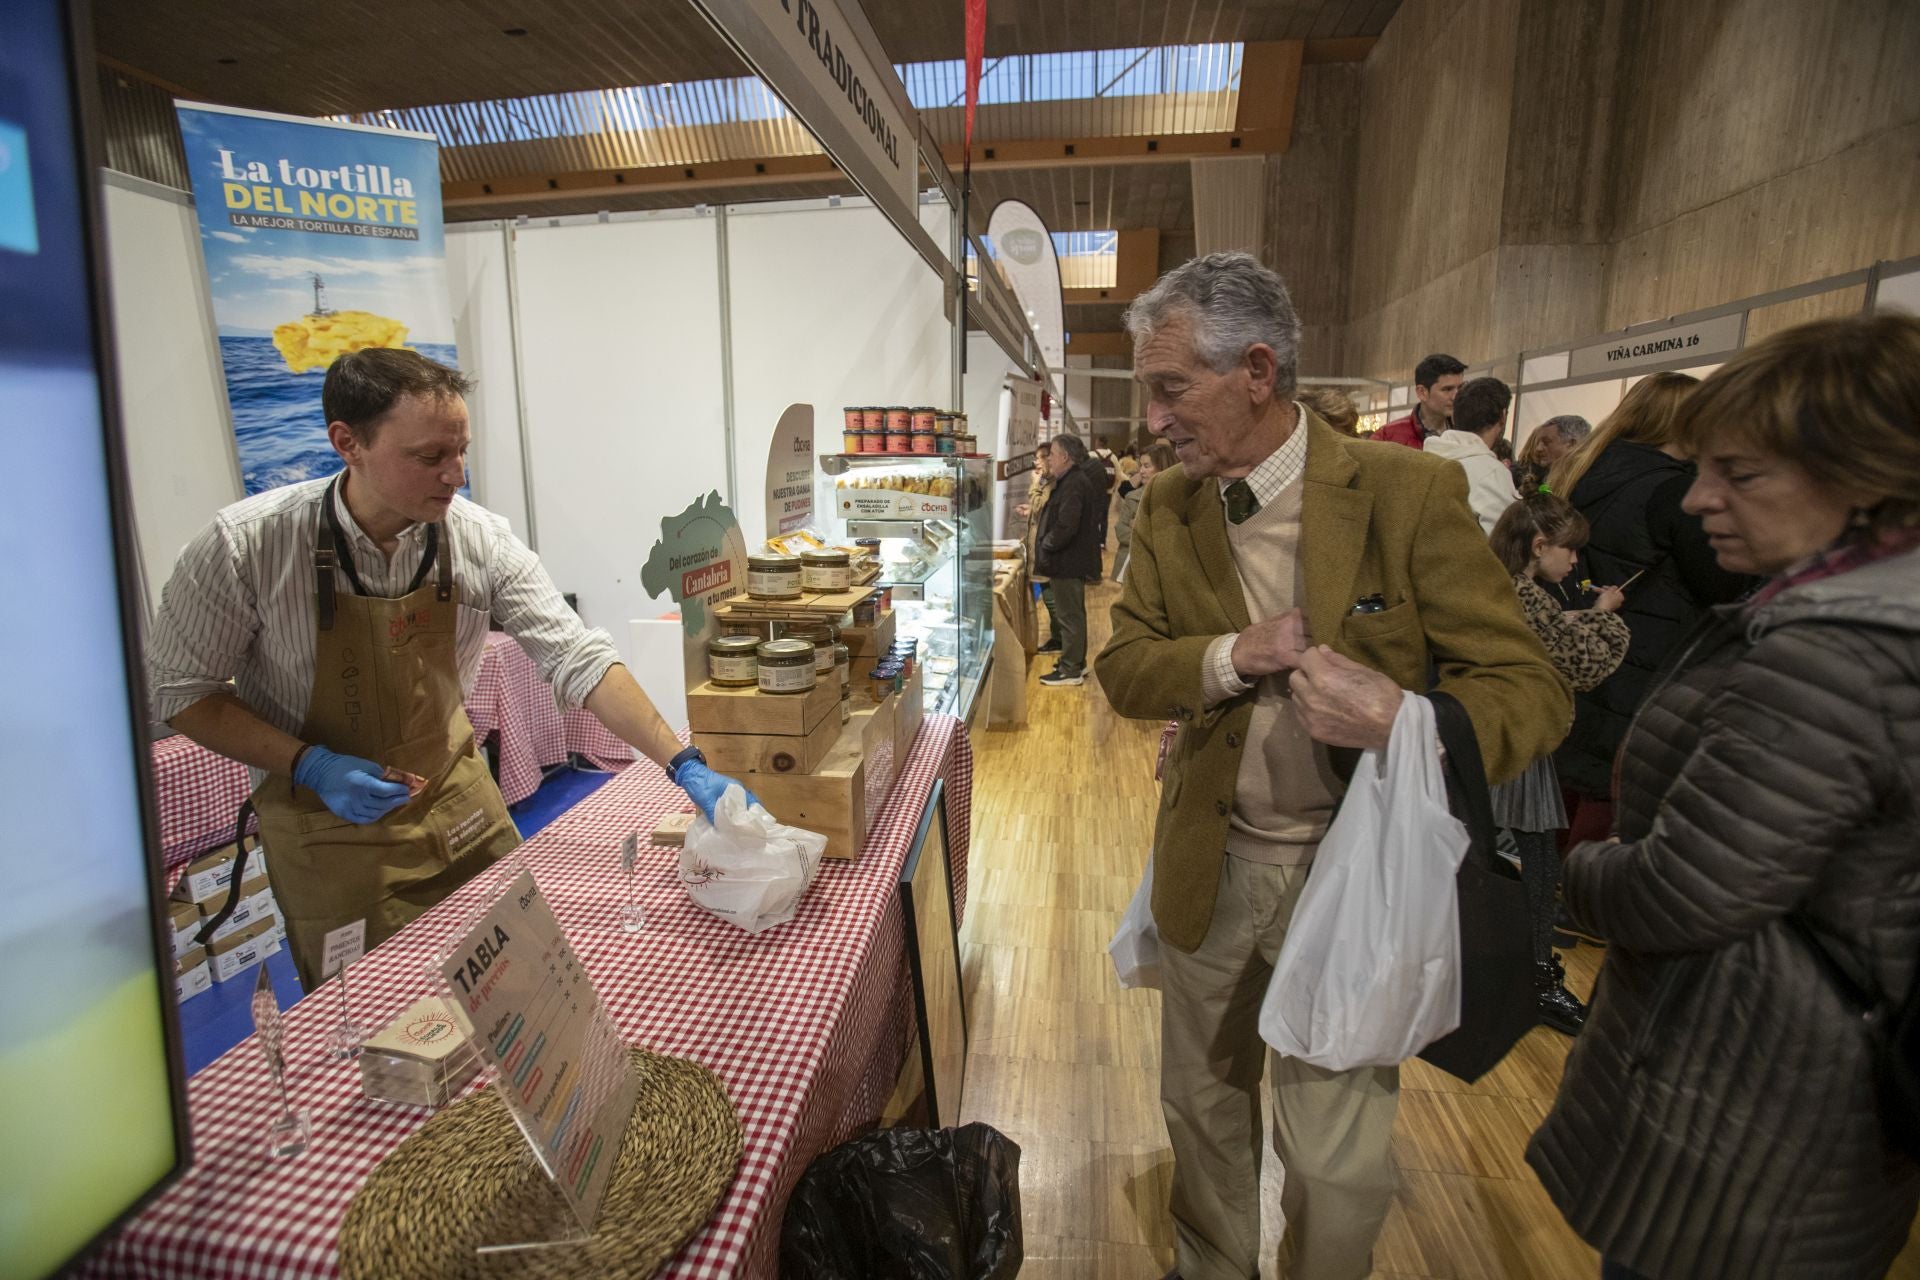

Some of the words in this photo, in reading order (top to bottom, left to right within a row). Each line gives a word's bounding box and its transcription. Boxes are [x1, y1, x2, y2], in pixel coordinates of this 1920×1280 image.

[796, 0, 900, 170] TRADICIONAL
[218, 149, 272, 183] La
[278, 158, 416, 199] tortilla
[223, 183, 294, 214] DEL
[300, 190, 418, 225] NORTE
[232, 214, 249, 225] LA
[252, 216, 295, 229] MEJOR
[298, 219, 351, 234] TORTILLA
[354, 224, 369, 236] DE
[372, 226, 417, 240] ESPAÑA
[1606, 345, 1630, 361] VIÑA
[1632, 336, 1683, 357] CARMINA
[1686, 334, 1700, 347] 16
[773, 486, 796, 500] NUESTRA
[784, 502, 791, 512] DE
[669, 555, 682, 571] Del
[683, 547, 709, 567] corazón
[710, 546, 719, 559] de
[685, 565, 728, 595] Cantabria
[707, 595, 713, 606] a
[713, 591, 720, 605] tu
[721, 587, 737, 600] mesa
[453, 924, 510, 994] TABLA
[469, 994, 482, 1013] de
[480, 957, 511, 1002] precios
